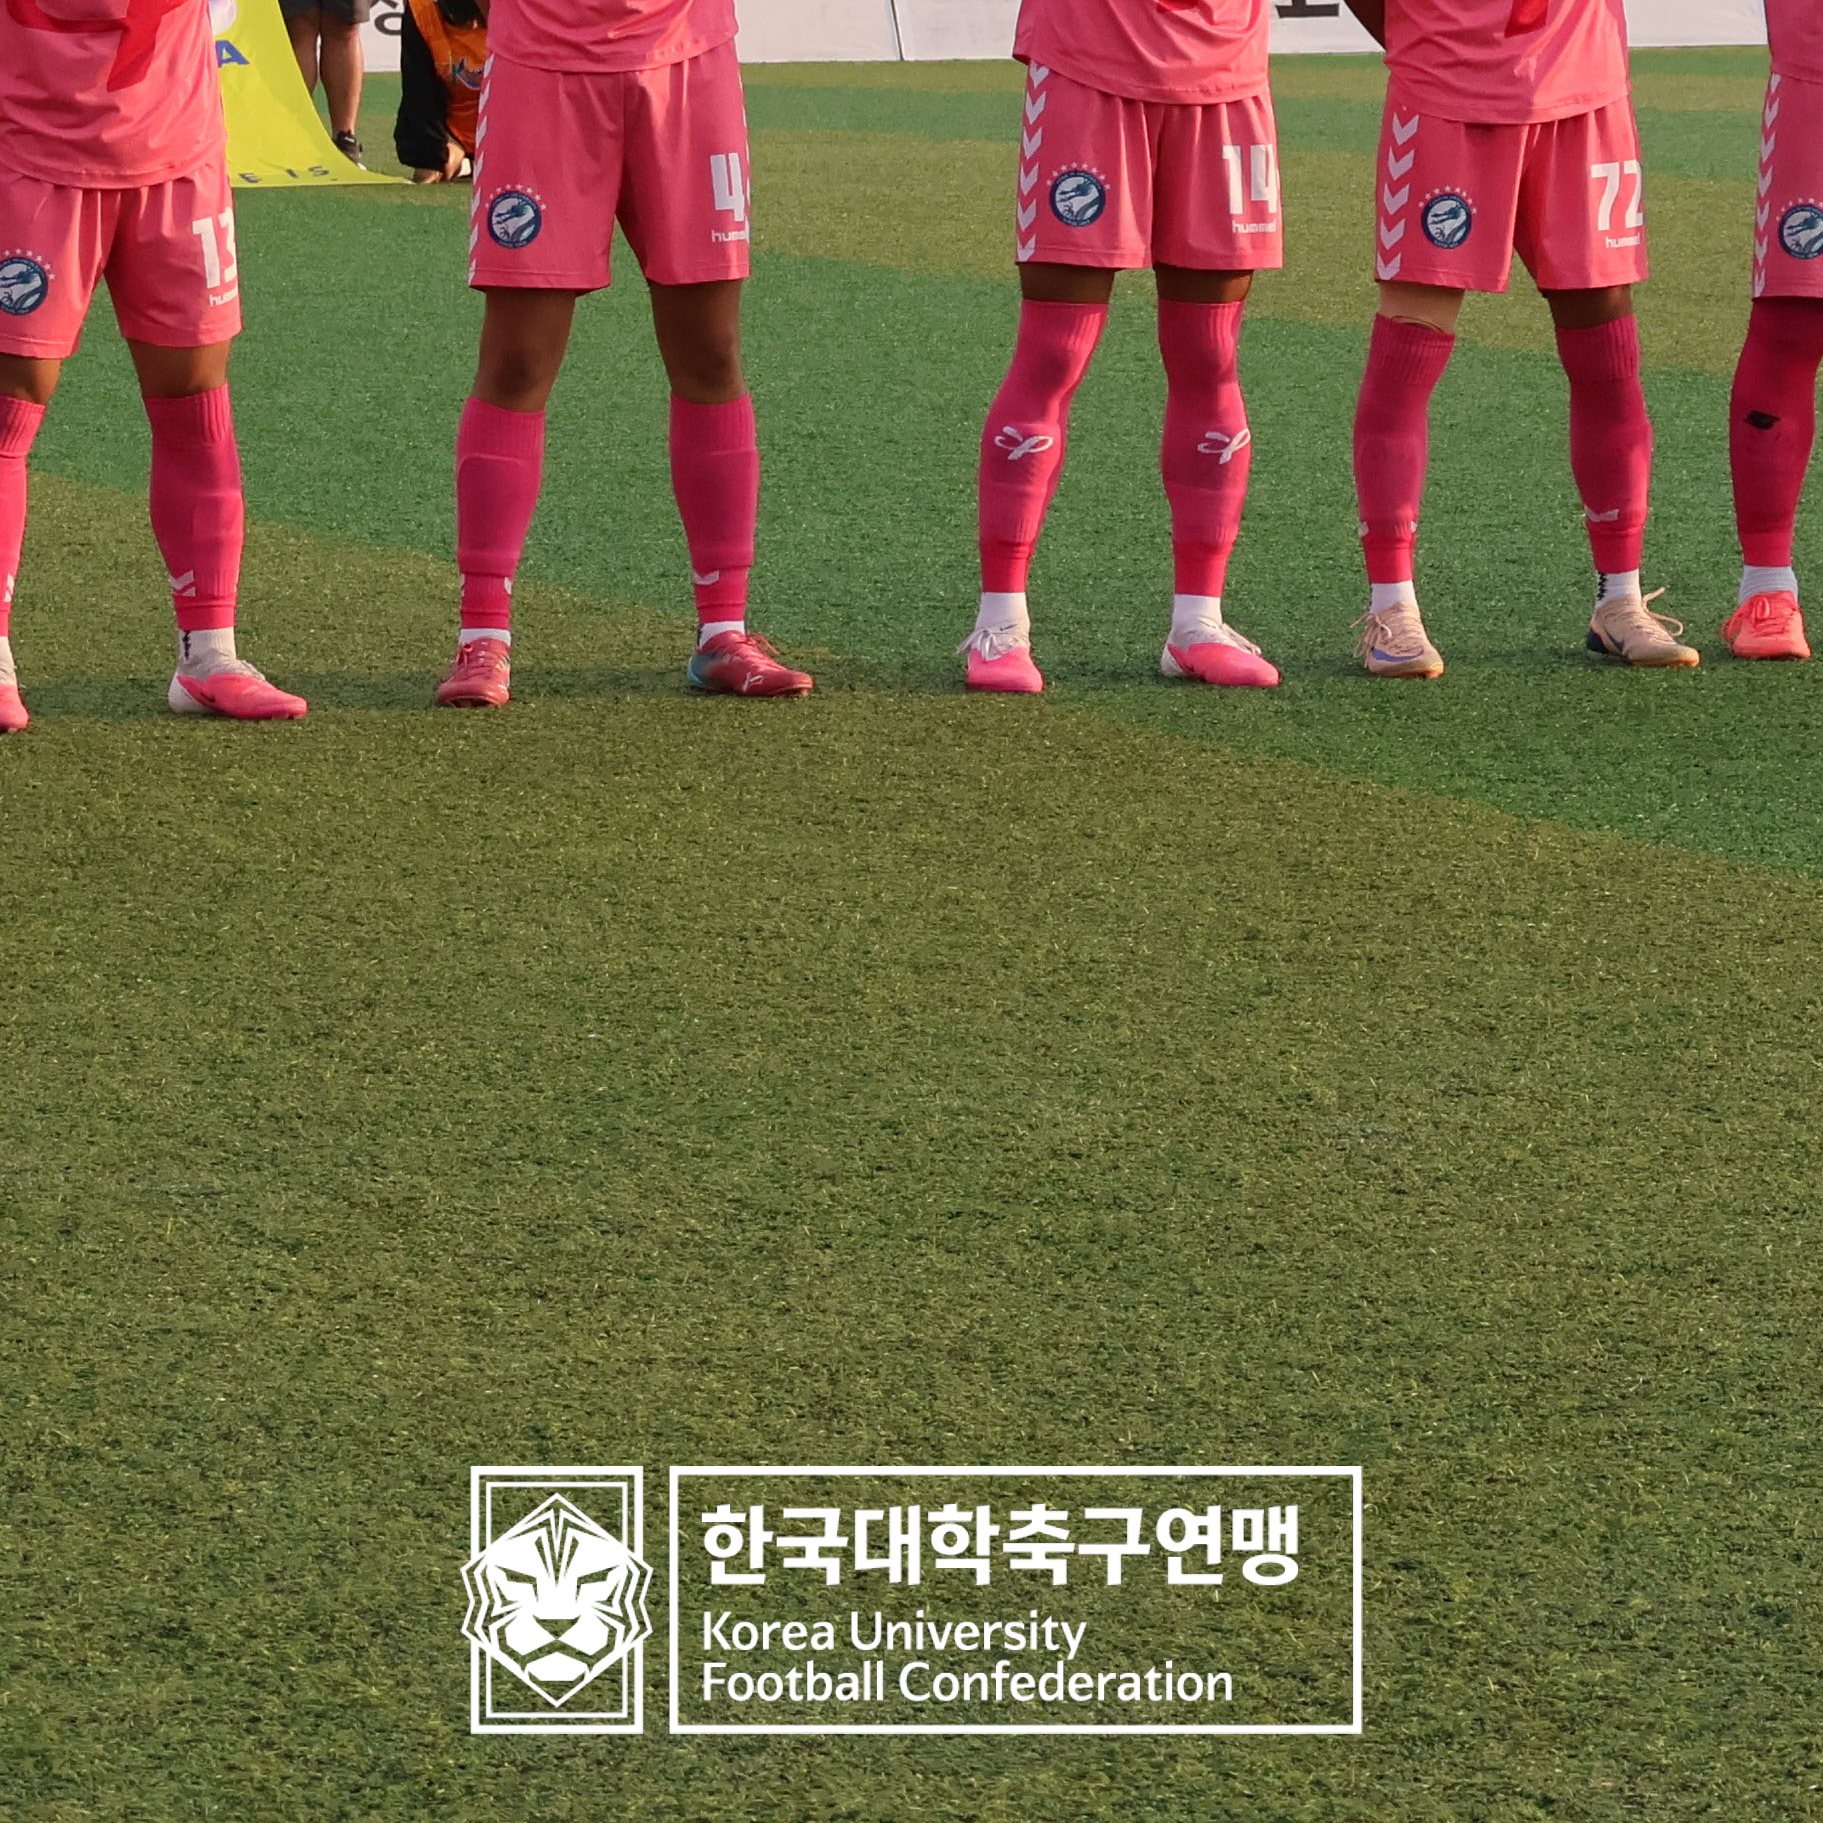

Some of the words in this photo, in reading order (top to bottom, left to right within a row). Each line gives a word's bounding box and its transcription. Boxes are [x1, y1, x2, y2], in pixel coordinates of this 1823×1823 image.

[710, 153, 744, 222] 4
[1223, 144, 1277, 214] 14
[1591, 161, 1643, 232] 72
